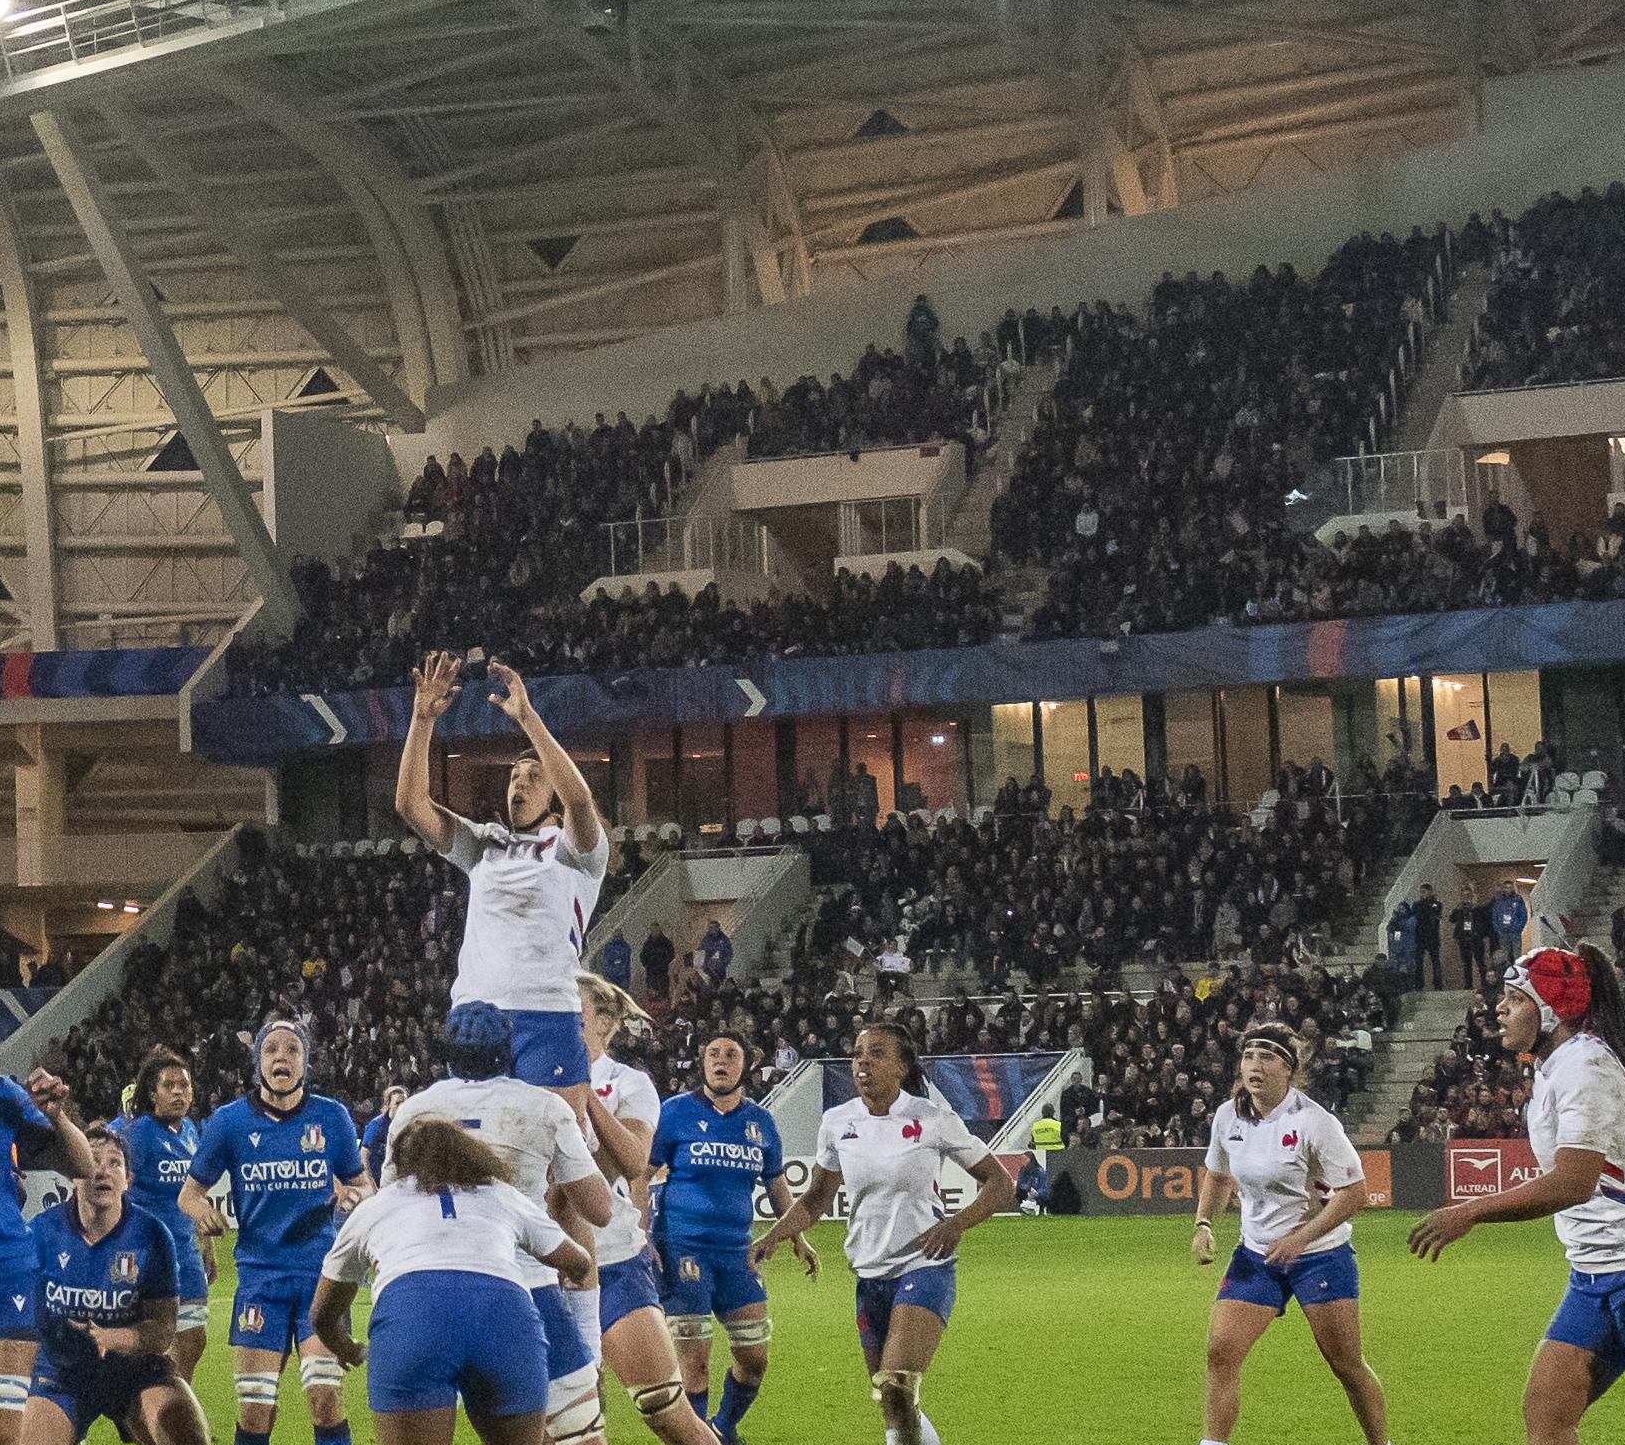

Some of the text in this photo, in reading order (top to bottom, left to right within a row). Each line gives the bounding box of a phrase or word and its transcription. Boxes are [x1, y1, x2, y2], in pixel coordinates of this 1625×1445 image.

[241, 1159, 328, 1180] CATTOLICA
[1097, 1155, 1208, 1200] Ora
[1509, 1167, 1543, 1181] ALT
[1456, 1184, 1497, 1194] ALTRAD
